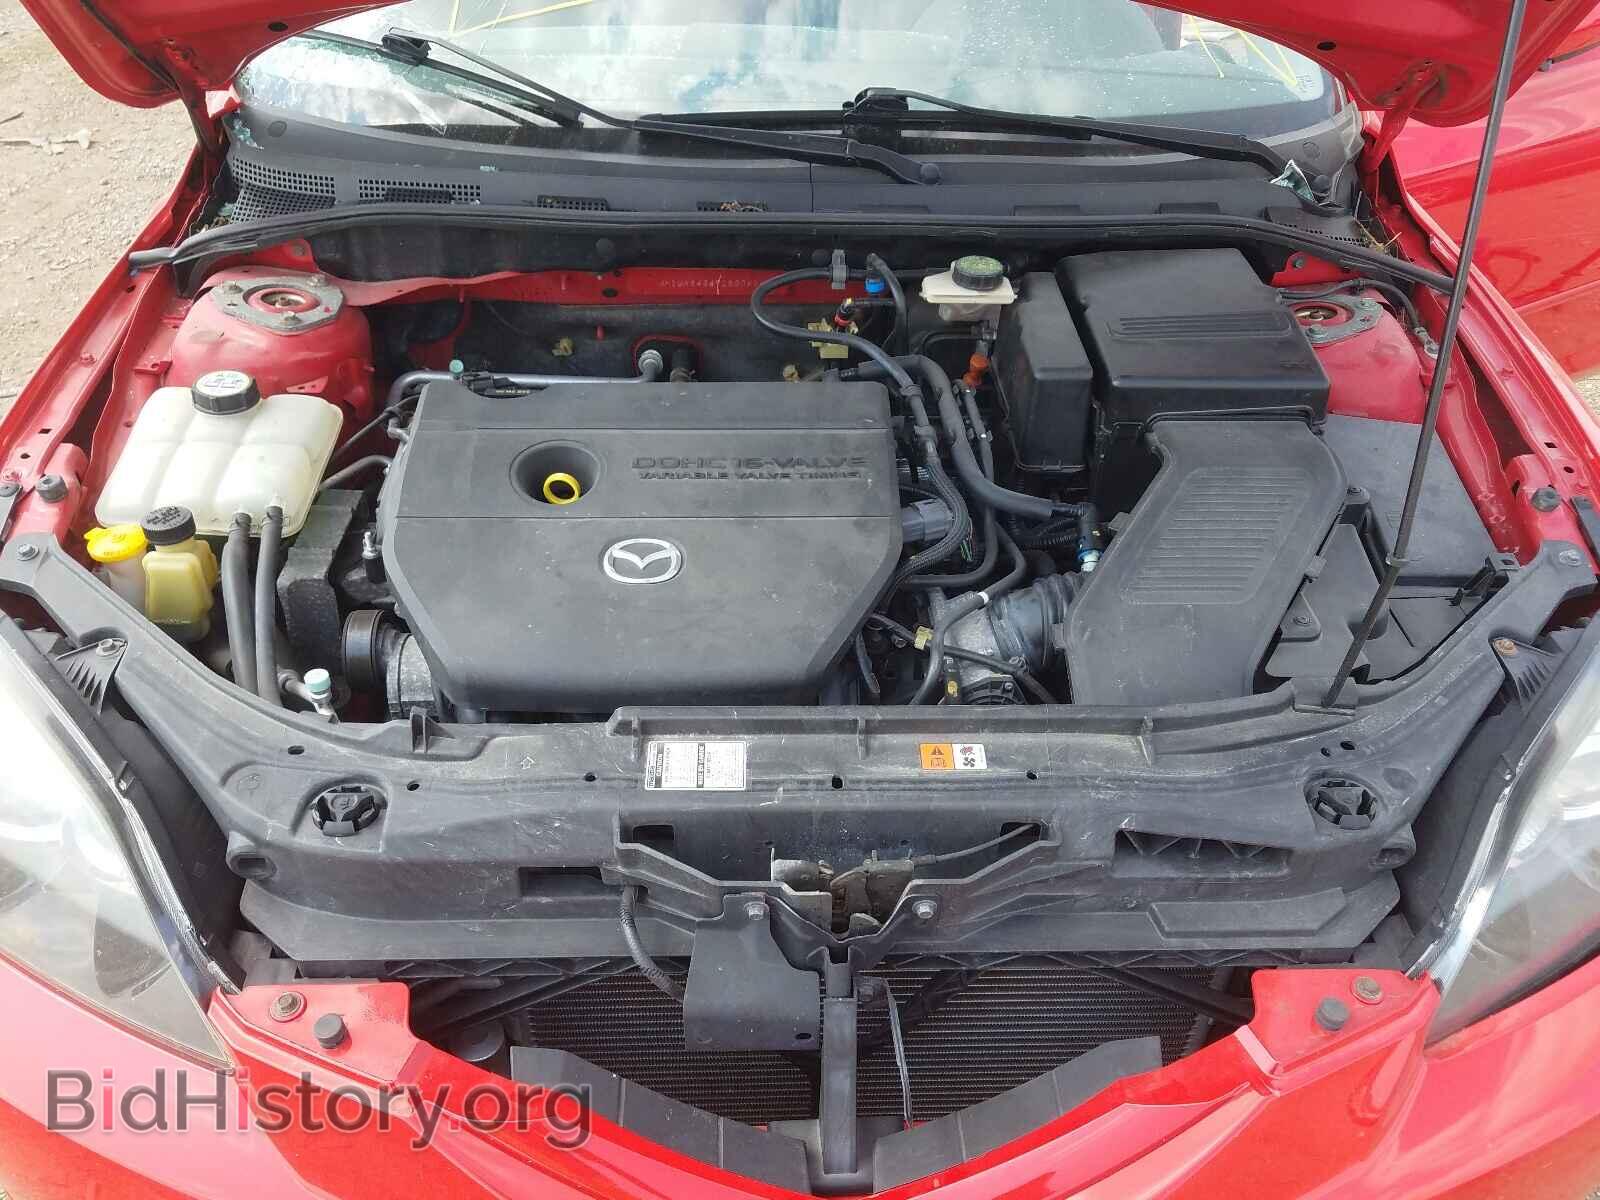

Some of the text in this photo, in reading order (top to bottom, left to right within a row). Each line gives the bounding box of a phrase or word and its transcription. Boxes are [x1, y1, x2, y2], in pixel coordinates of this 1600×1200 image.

[631, 456, 868, 469] DOHC 16-VALVE
[639, 470, 864, 480] VARIABLE VALVE TIMING
